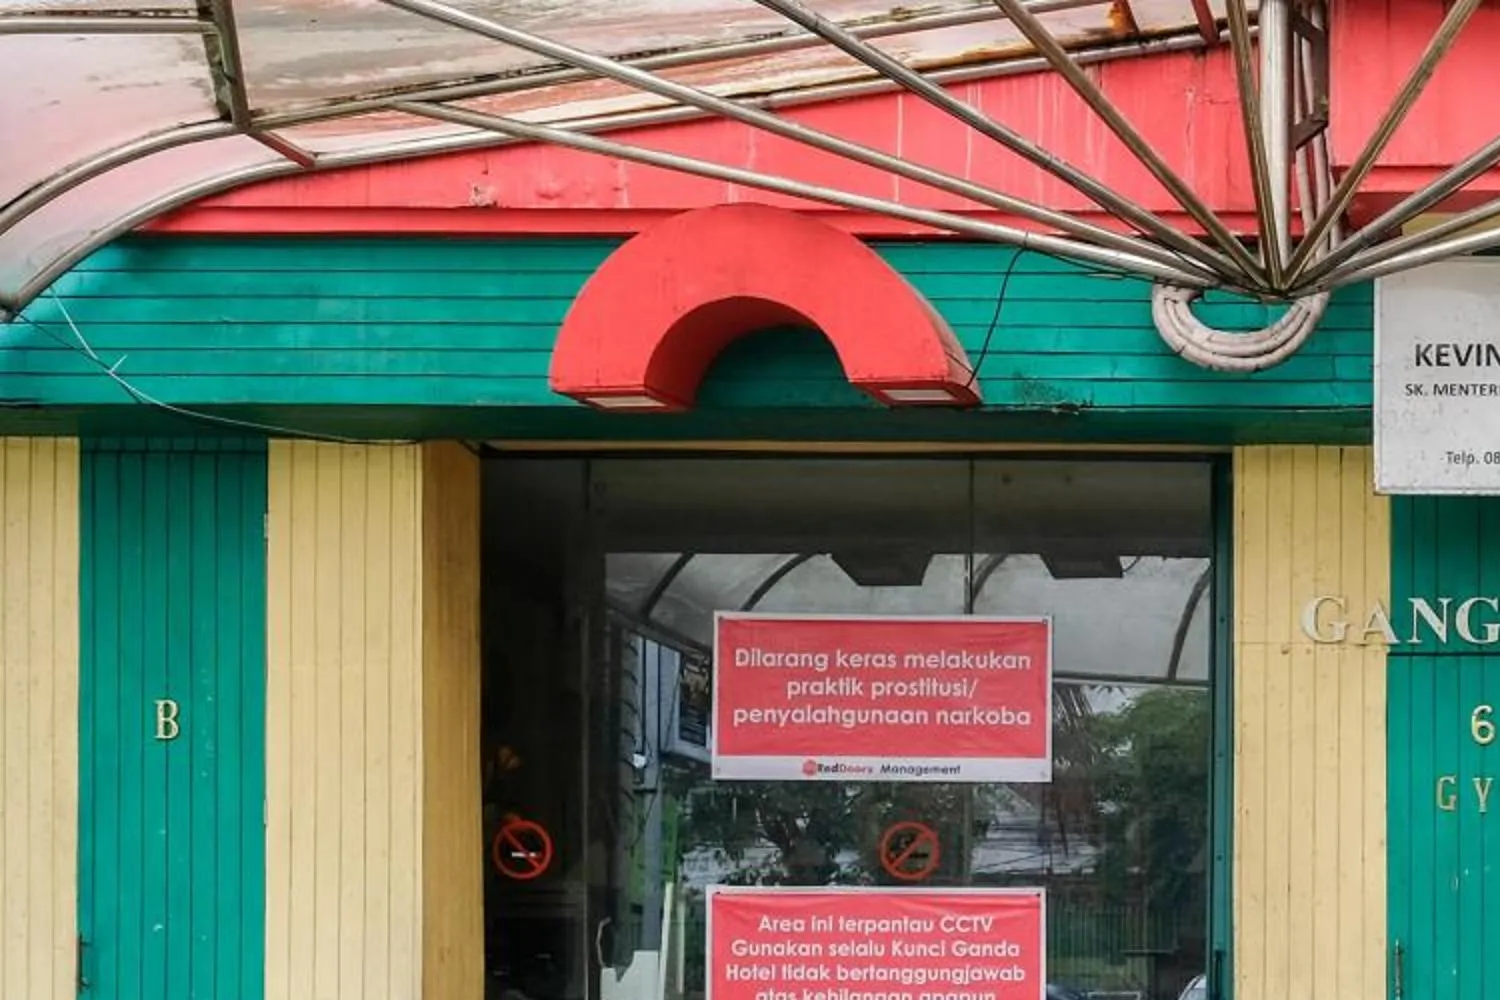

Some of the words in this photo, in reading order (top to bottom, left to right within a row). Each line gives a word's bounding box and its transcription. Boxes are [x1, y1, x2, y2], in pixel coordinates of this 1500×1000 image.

[1405, 383, 1428, 397] SK.
[1446, 451, 1480, 468] Telp.
[735, 647, 829, 672] Dilarang
[835, 648, 897, 669] keras
[903, 649, 1031, 670] melakukan
[787, 677, 864, 699] praktik
[871, 678, 979, 700] prostitusi/
[153, 698, 180, 740] B
[733, 705, 929, 729] penyalahgunaan
[935, 706, 1032, 726] narkoba
[1470, 704, 1497, 745] 6
[758, 914, 806, 933] Area
[811, 915, 833, 932] ini
[838, 915, 935, 936] terpantau
[939, 915, 996, 934] CCTV
[731, 939, 823, 957] Gunakan
[828, 939, 886, 957] selalu
[891, 939, 946, 957] Kunci
[951, 940, 1020, 957] Ganda
[725, 963, 776, 981] Hotel
[781, 963, 831, 981] tidak
[836, 963, 1026, 985] bertanggungjawab
